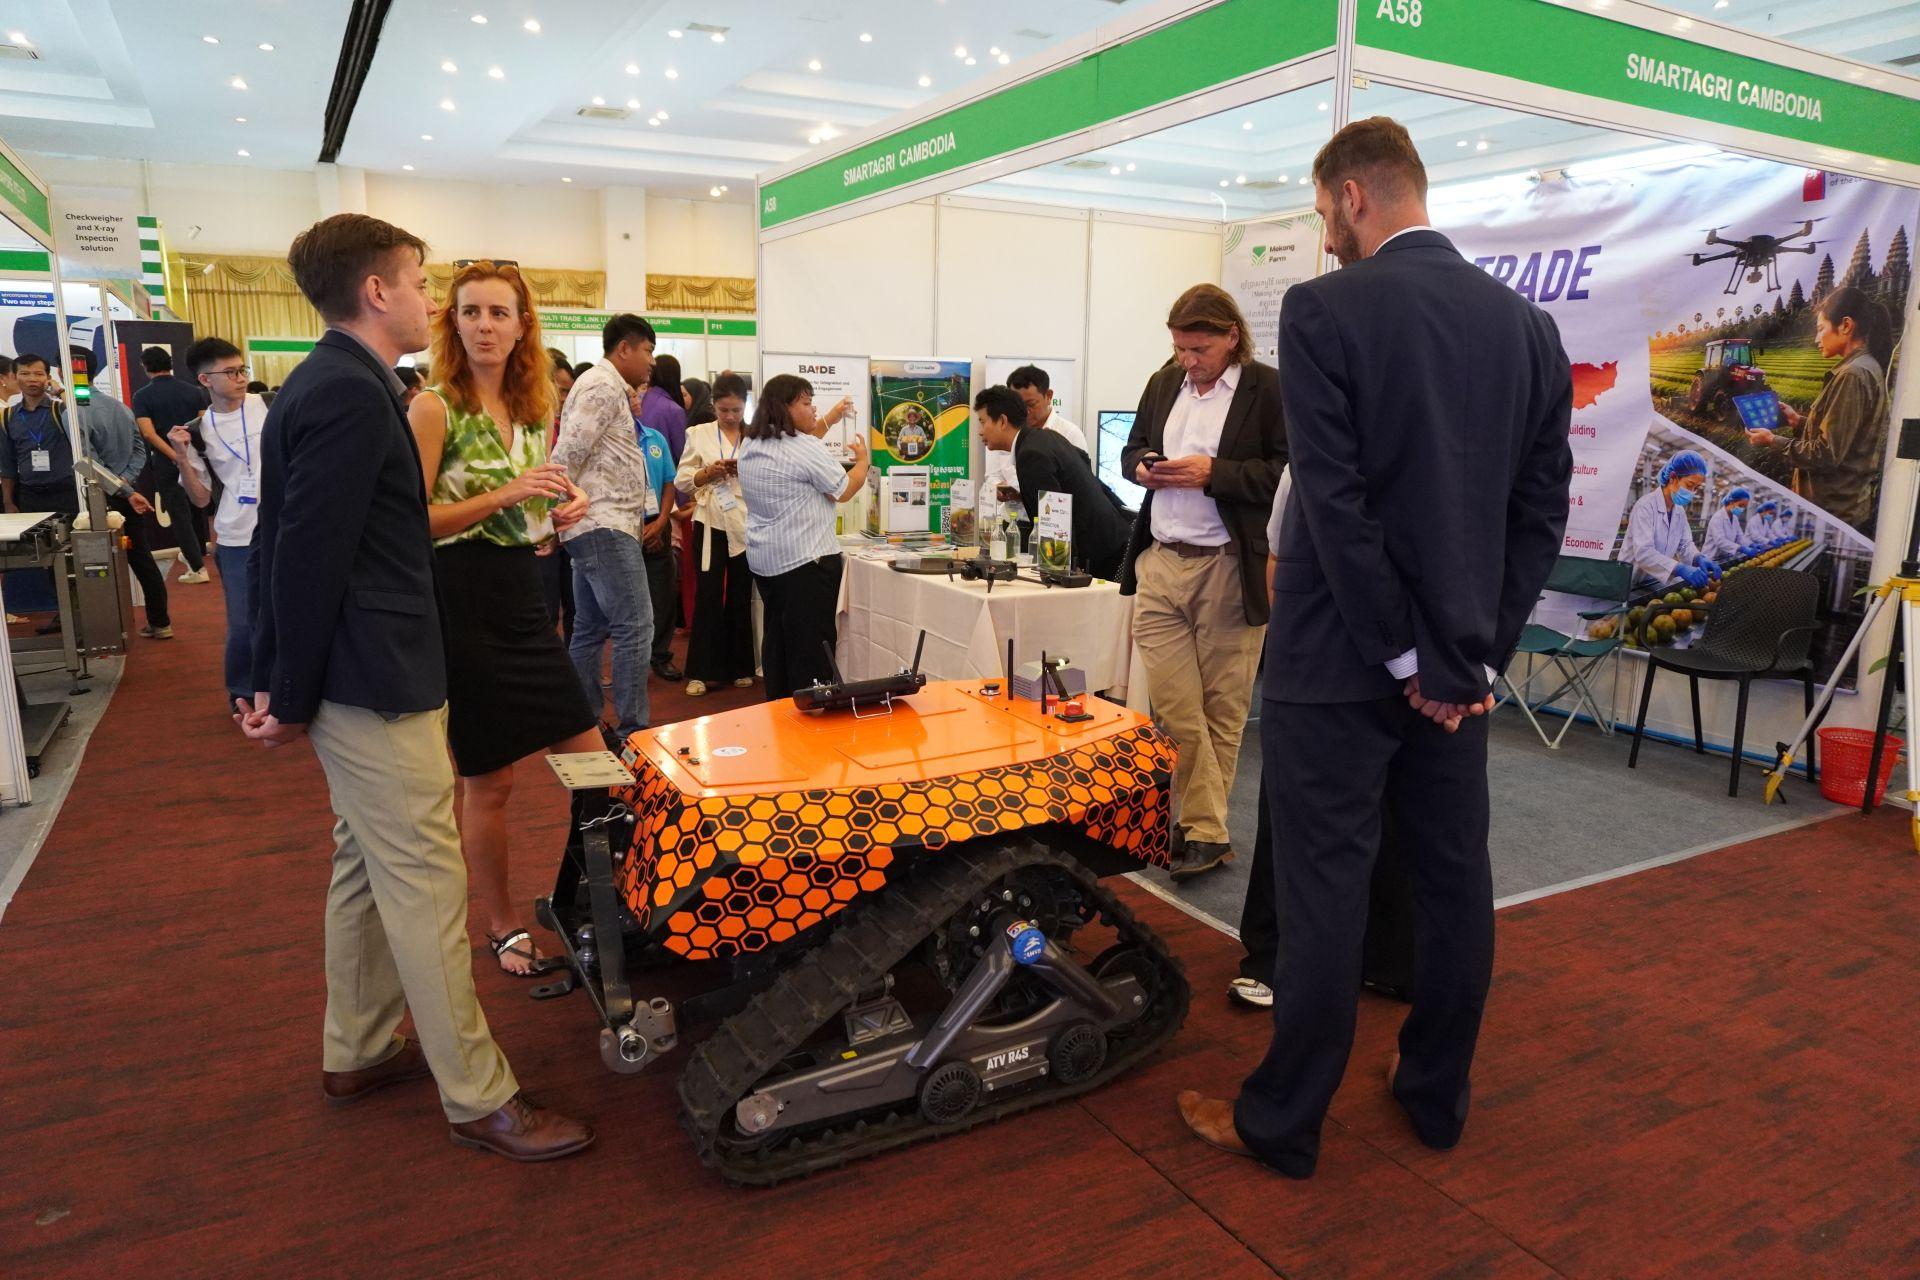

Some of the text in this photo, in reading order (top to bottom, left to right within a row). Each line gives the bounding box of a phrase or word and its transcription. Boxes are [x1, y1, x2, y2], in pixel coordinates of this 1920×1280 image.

[1376, 0, 1422, 27] A58
[1626, 53, 1822, 122] SMARTAGRI CAMBODIA
[843, 131, 956, 187] SMARTAGRI CAMBODIA
[764, 196, 777, 213] A58
[65, 213, 124, 223] Checkweigher
[75, 234, 119, 243] Inspection
[1269, 244, 1295, 253] Mekong
[1474, 244, 1602, 303] TRADE
[1569, 424, 1596, 438] uilding
[1570, 464, 1598, 475] culture
[1565, 536, 1604, 550] Economic
[986, 1047, 1029, 1070] ATV R4S
